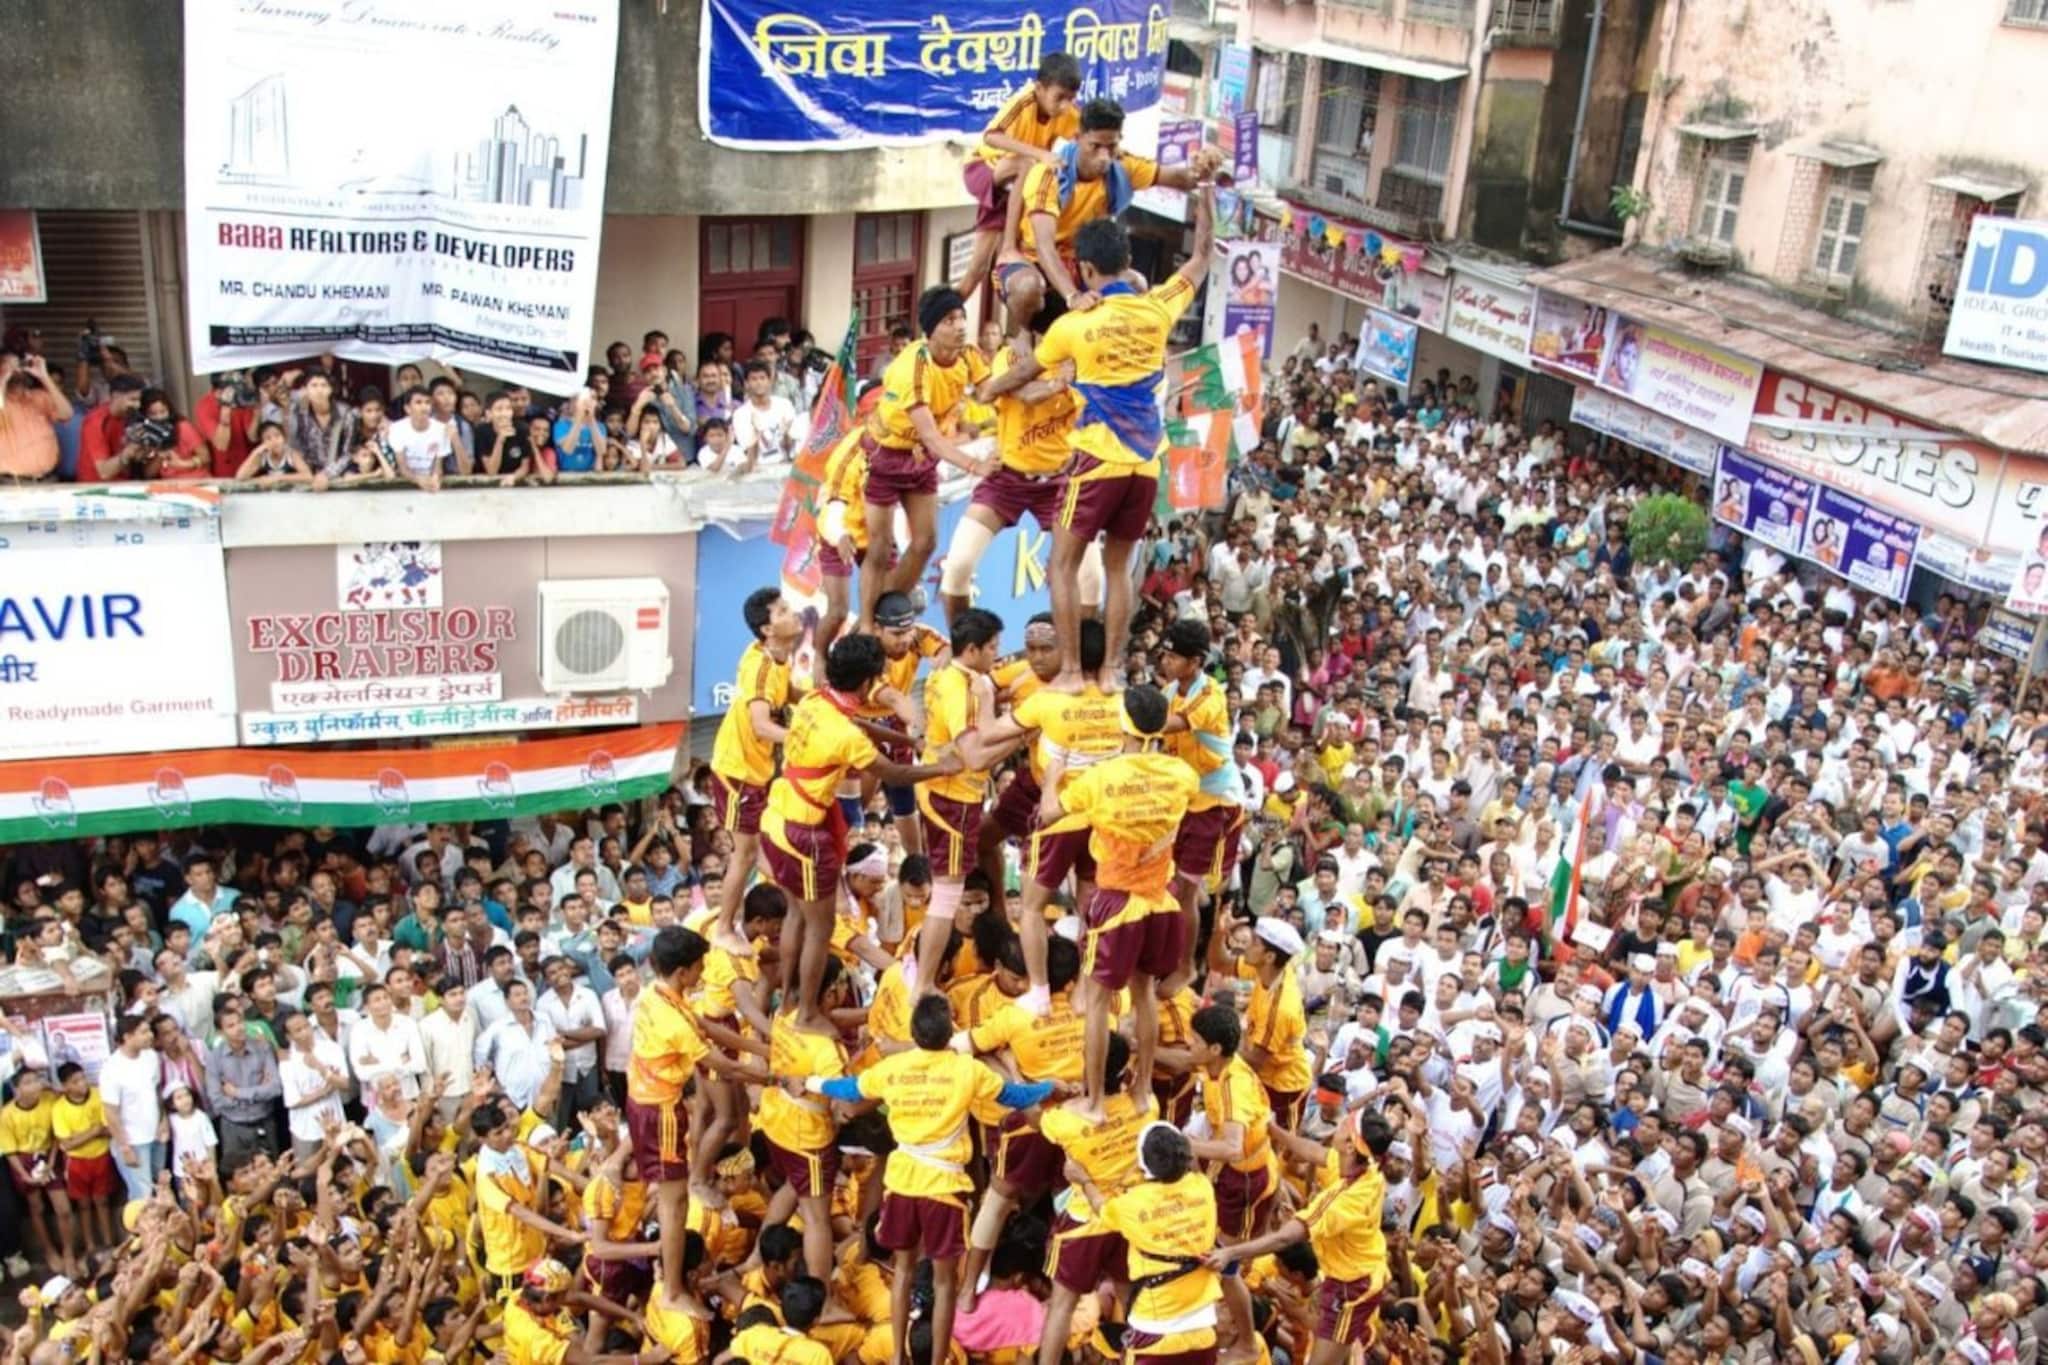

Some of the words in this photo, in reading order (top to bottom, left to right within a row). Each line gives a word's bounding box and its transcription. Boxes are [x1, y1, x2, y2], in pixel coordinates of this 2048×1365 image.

[752, 12, 892, 78] जिवा
[919, 13, 1045, 76] देवशी
[1064, 8, 1142, 64] निवास
[290, 228, 407, 254] REALTORS
[435, 231, 574, 272] DEVELOPERS
[219, 279, 247, 296] MR.
[252, 281, 317, 299] CHANDU
[322, 285, 390, 300] KHEMANI
[421, 281, 447, 299] MR.
[450, 288, 504, 313] PAWAN
[507, 299, 571, 321] KHEMANI
[1963, 297, 2006, 315] IDEAL
[1959, 337, 1997, 354] Health
[0, 593, 145, 642] AVIR
[249, 607, 516, 651] EXCELSIOR
[277, 641, 498, 682] DRAPERS
[8, 702, 124, 722] Readymade
[130, 696, 214, 715] Garment
